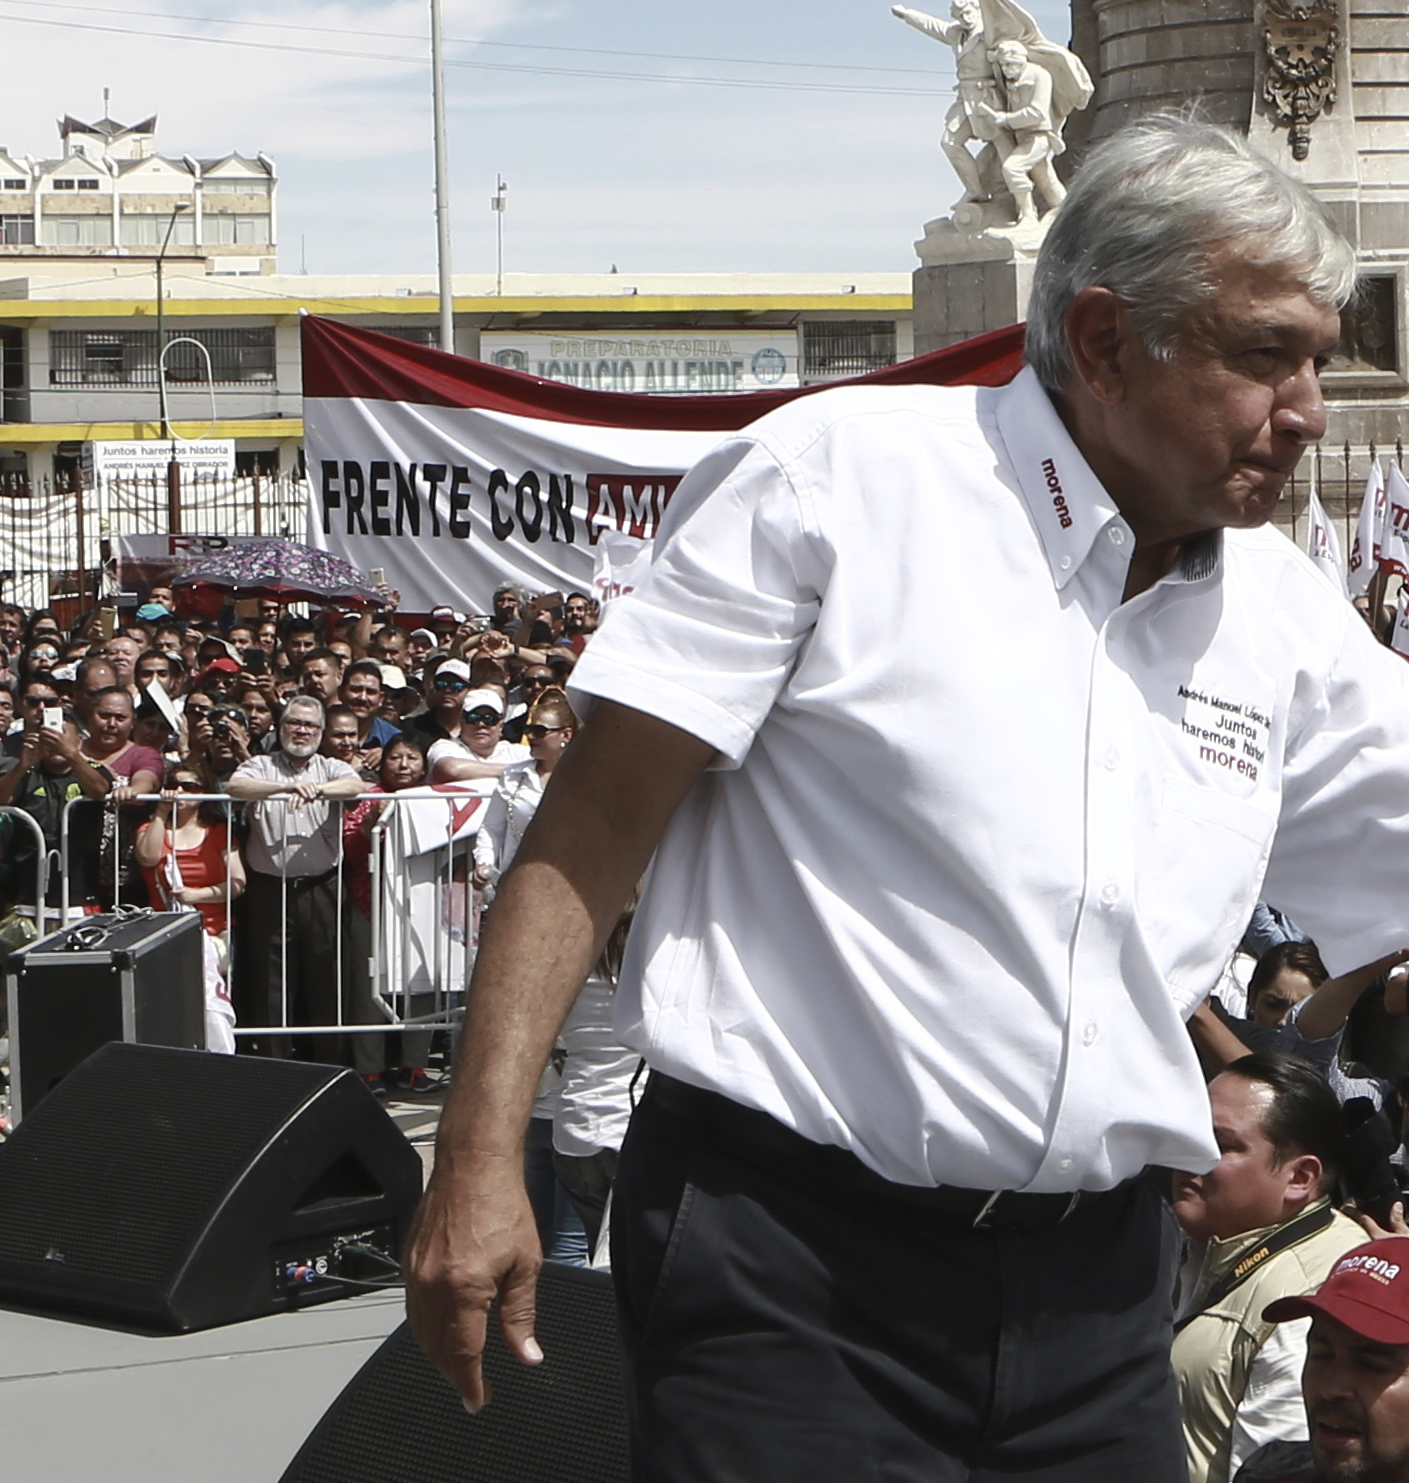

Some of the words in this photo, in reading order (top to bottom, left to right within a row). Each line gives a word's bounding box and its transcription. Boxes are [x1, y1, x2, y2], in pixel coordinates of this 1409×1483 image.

[550, 339, 733, 358] PREPARATORIA
[537, 358, 636, 393] IGNACIO
[644, 357, 744, 392] ALLENDE
[189, 445, 229, 455] historia
[321, 459, 473, 540] FRENTE
[488, 468, 575, 544] CON
[1041, 457, 1073, 530] morena
[1181, 717, 1237, 750] haremos
[1215, 714, 1257, 741] Juntos
[1200, 745, 1258, 782] morena
[1234, 1246, 1270, 1278] Nikon
[1336, 1256, 1400, 1280] morena
